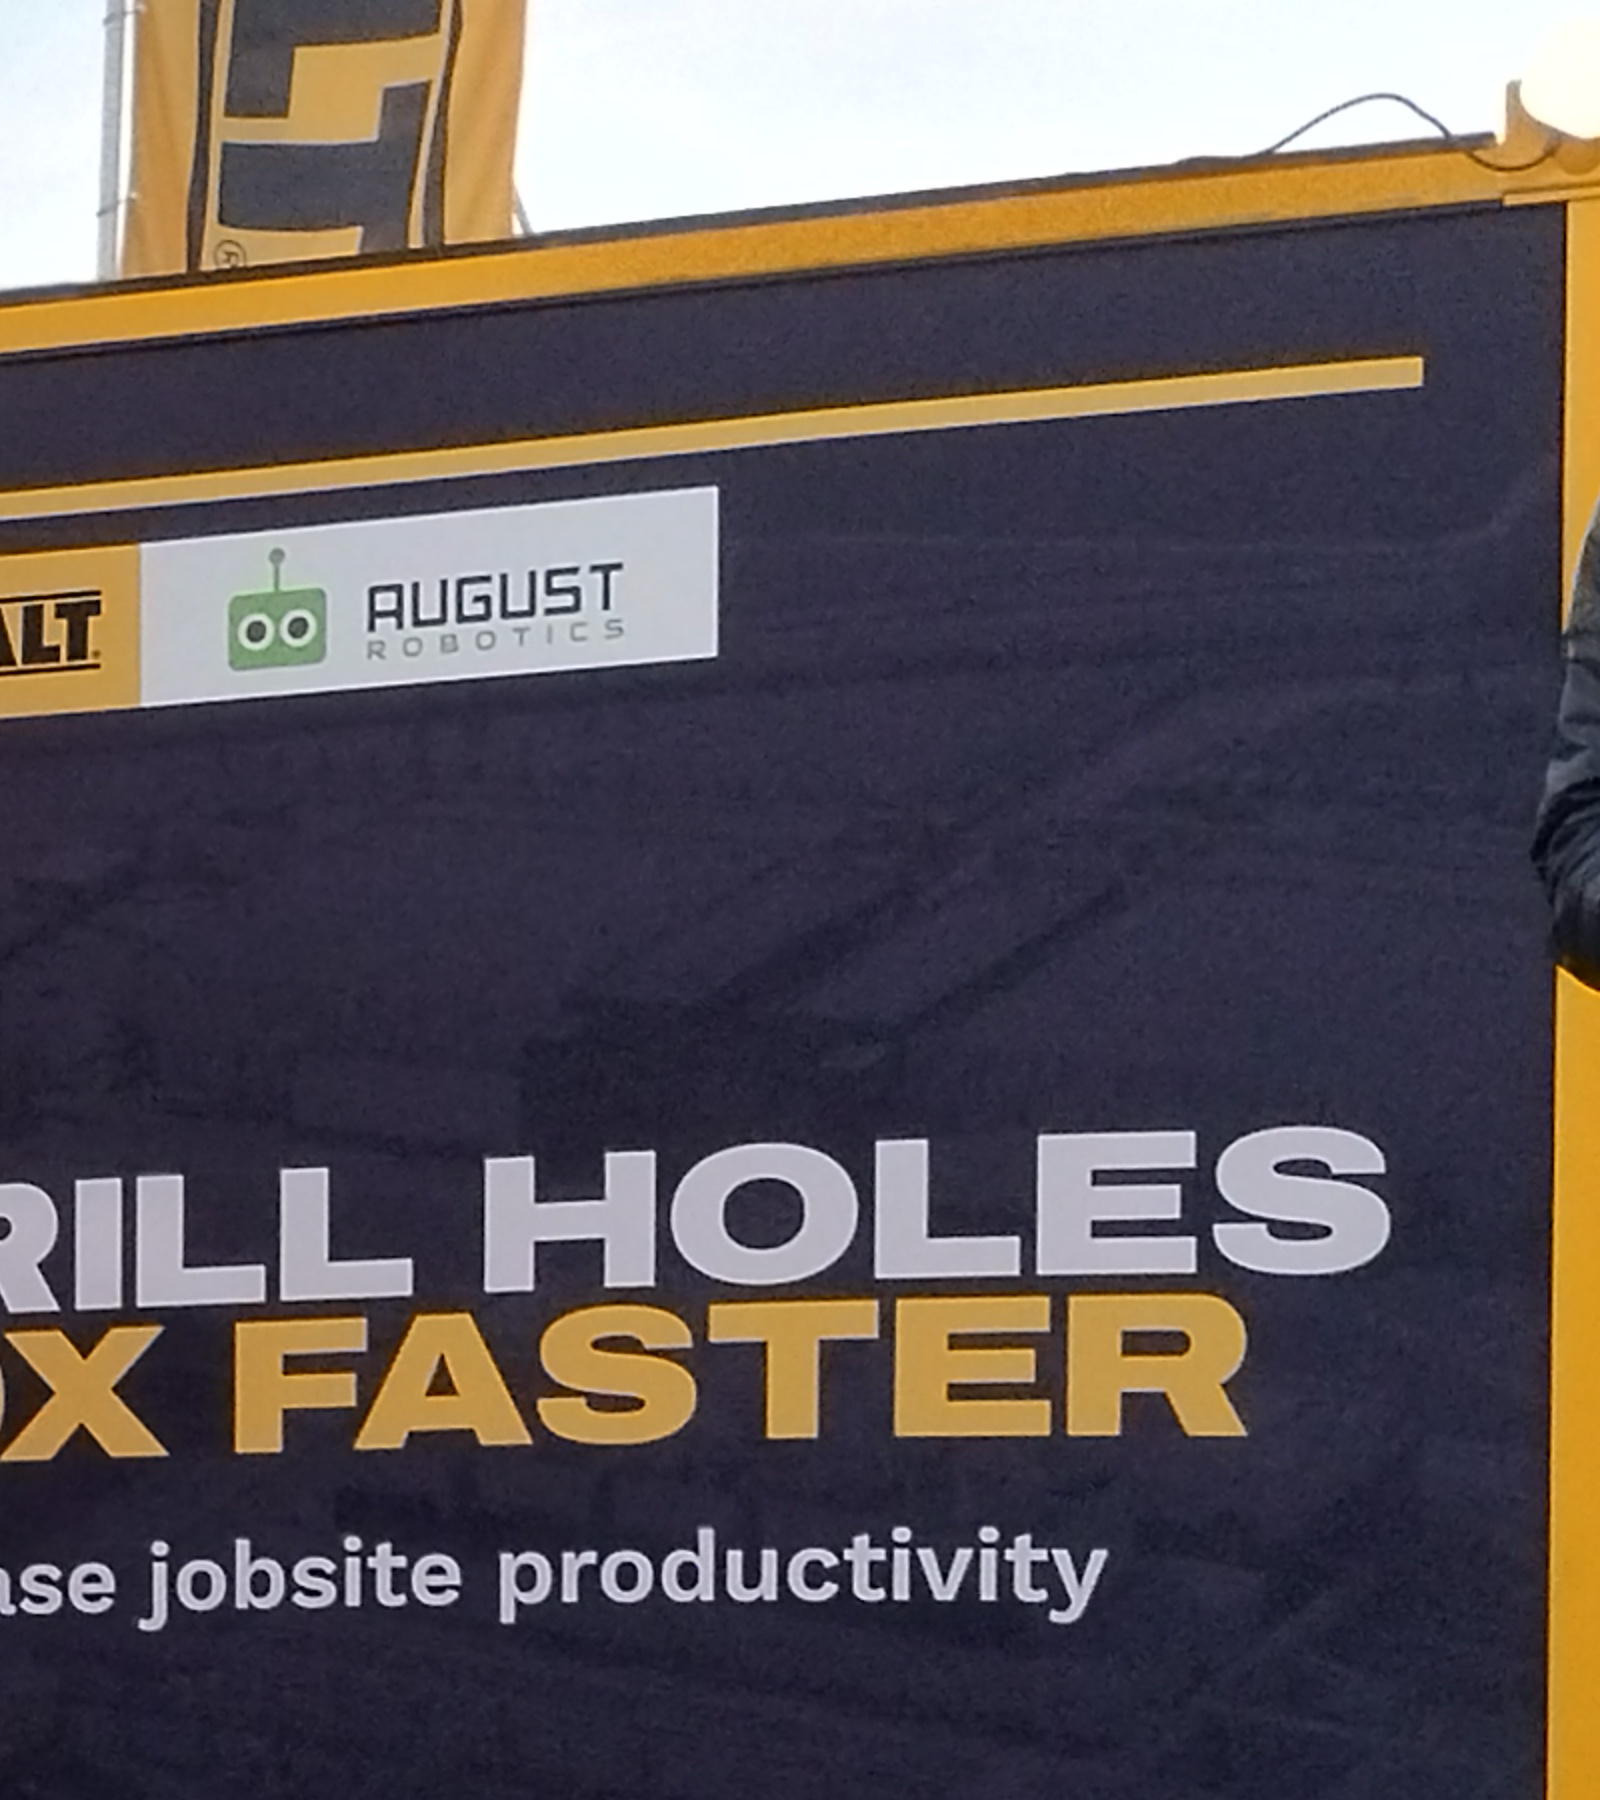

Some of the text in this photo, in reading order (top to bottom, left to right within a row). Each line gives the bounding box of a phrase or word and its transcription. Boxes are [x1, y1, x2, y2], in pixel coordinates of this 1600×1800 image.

[367, 561, 623, 633] AUGUST
[367, 616, 626, 660] ROBOTICS
[484, 1125, 1392, 1293] HOLES
[234, 1292, 1248, 1454] FASTER
[139, 1534, 462, 1632] jobsite
[497, 1526, 1109, 1625] productivity
